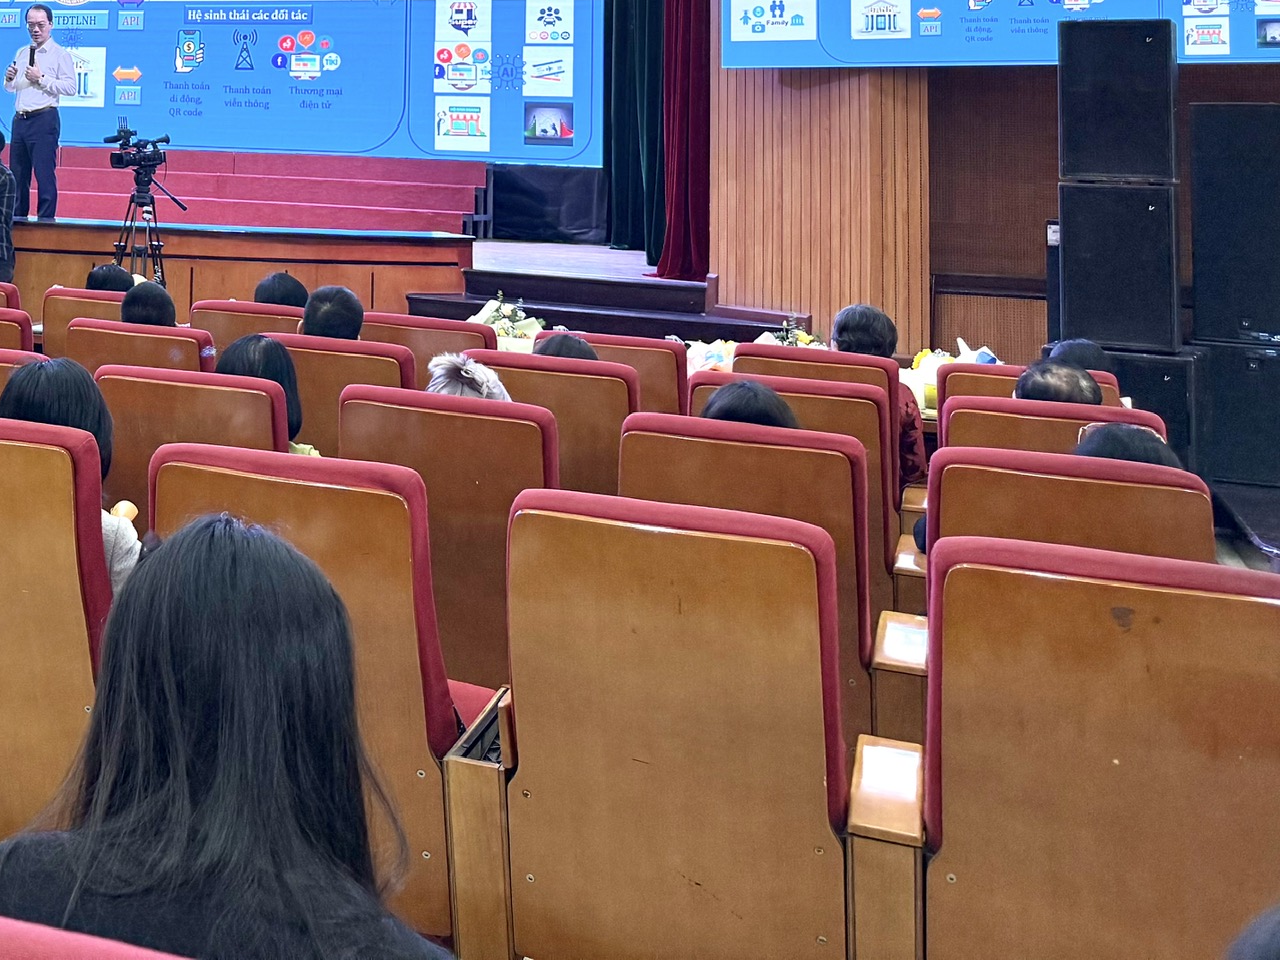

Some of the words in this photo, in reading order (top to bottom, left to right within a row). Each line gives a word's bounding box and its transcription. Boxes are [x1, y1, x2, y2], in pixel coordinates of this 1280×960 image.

[1, 15, 16, 23] API
[188, 9, 202, 22] Hệ
[204, 10, 227, 20] sinh
[229, 9, 250, 20] thái
[252, 10, 269, 20] các
[271, 9, 288, 20] đối
[291, 10, 307, 20] tác
[55, 16, 96, 25] TĐTLNH
[122, 17, 139, 25] API
[502, 68, 513, 77] AI
[192, 82, 210, 90] toán
[223, 86, 249, 94] Thanh
[252, 86, 271, 94] toán
[289, 86, 325, 95] Thương
[326, 87, 342, 96] mại
[120, 92, 136, 101] API
[245, 99, 269, 109] thông
[169, 109, 181, 117] QR
